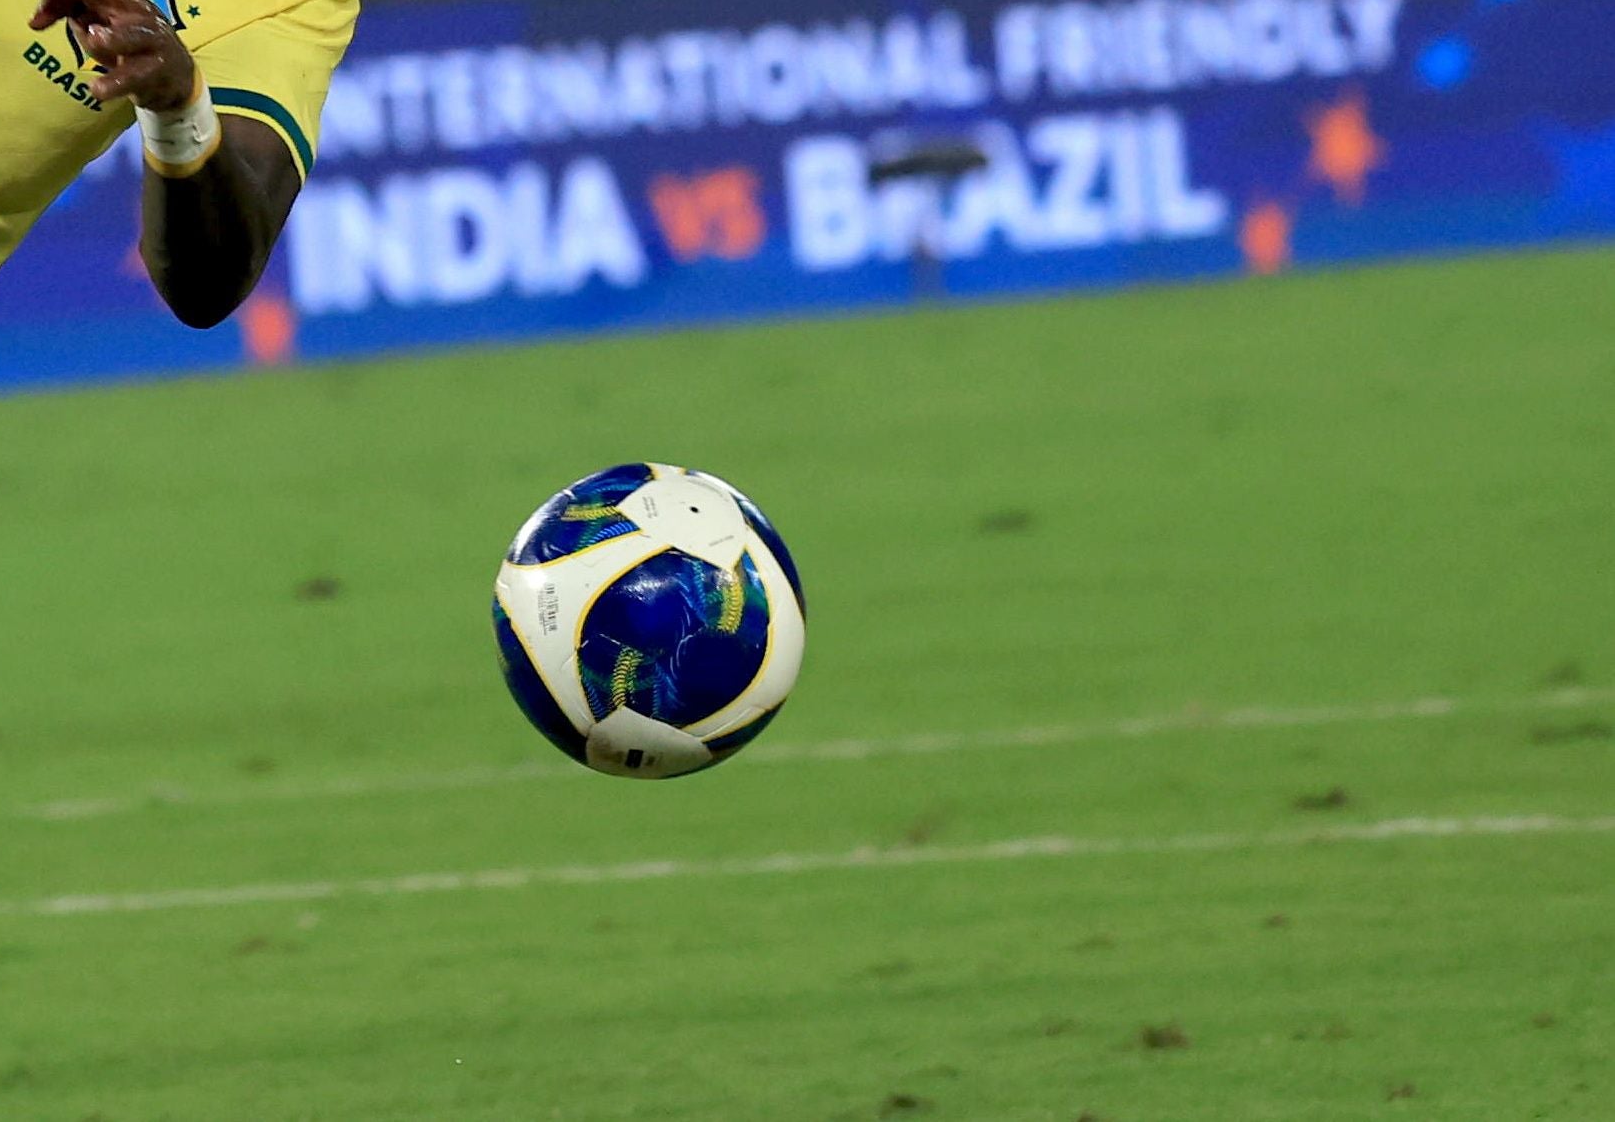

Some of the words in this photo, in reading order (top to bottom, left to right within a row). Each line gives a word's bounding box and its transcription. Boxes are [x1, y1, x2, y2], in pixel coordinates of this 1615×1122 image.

[23, 41, 103, 112] BRASIL
[318, 13, 983, 156] NTERNATIONAL
[290, 160, 644, 311] INDIA
